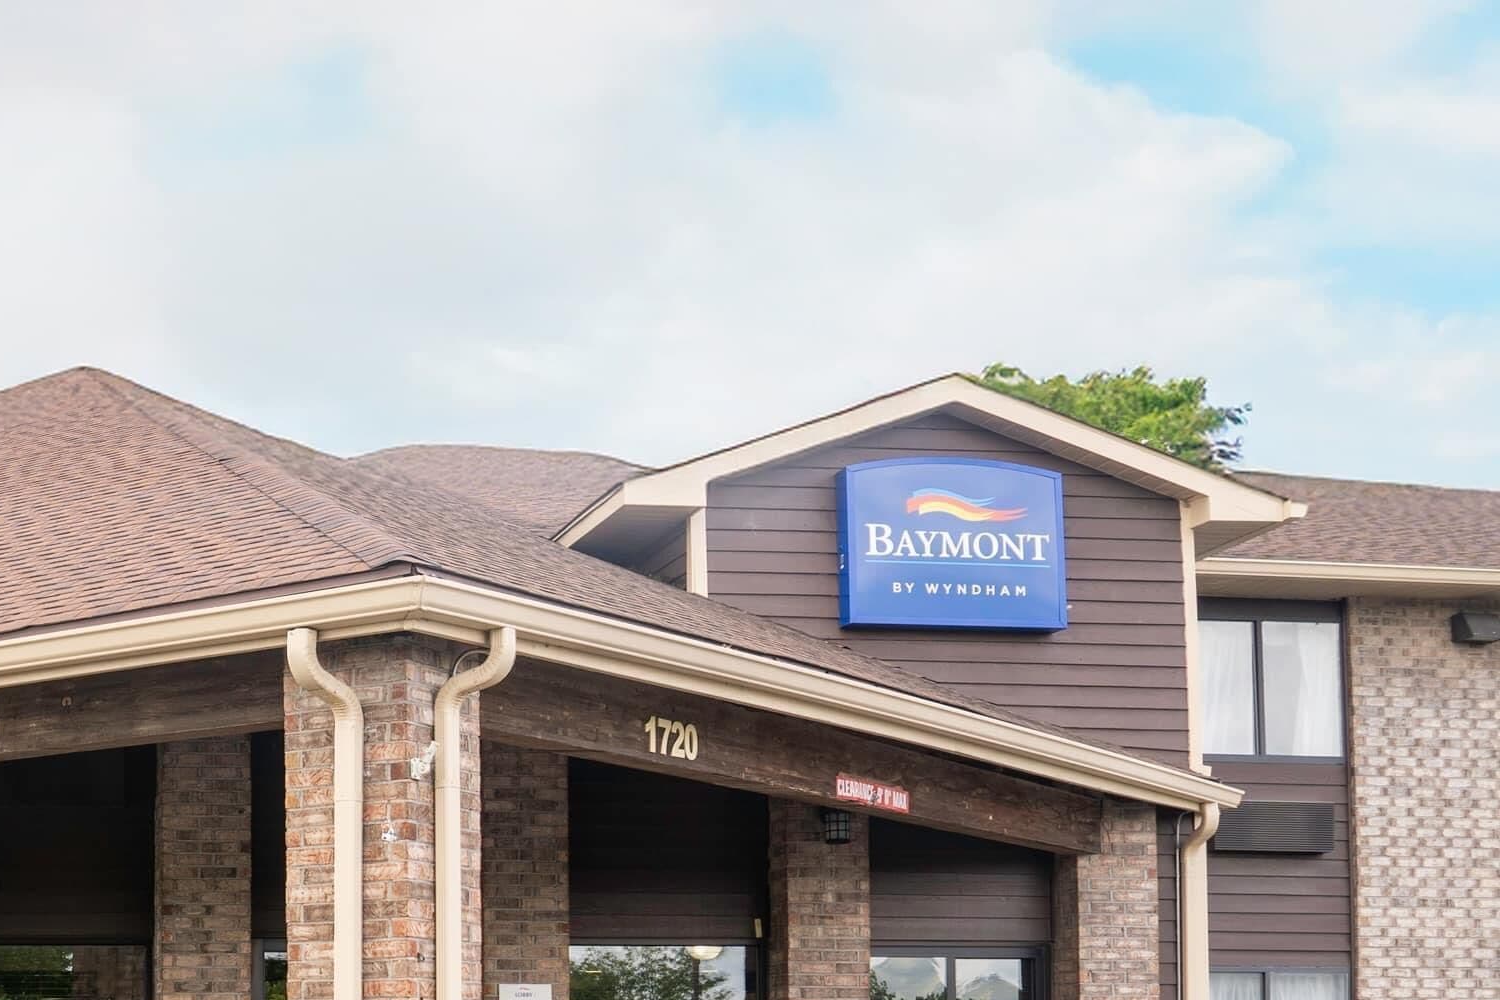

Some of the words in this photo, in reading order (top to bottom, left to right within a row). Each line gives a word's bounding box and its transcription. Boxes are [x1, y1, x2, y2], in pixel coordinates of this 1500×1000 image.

[864, 523, 1050, 561] BAYMONT
[892, 582, 915, 594] BY
[925, 583, 1027, 597] WYNDHAM
[645, 715, 699, 761] 1720
